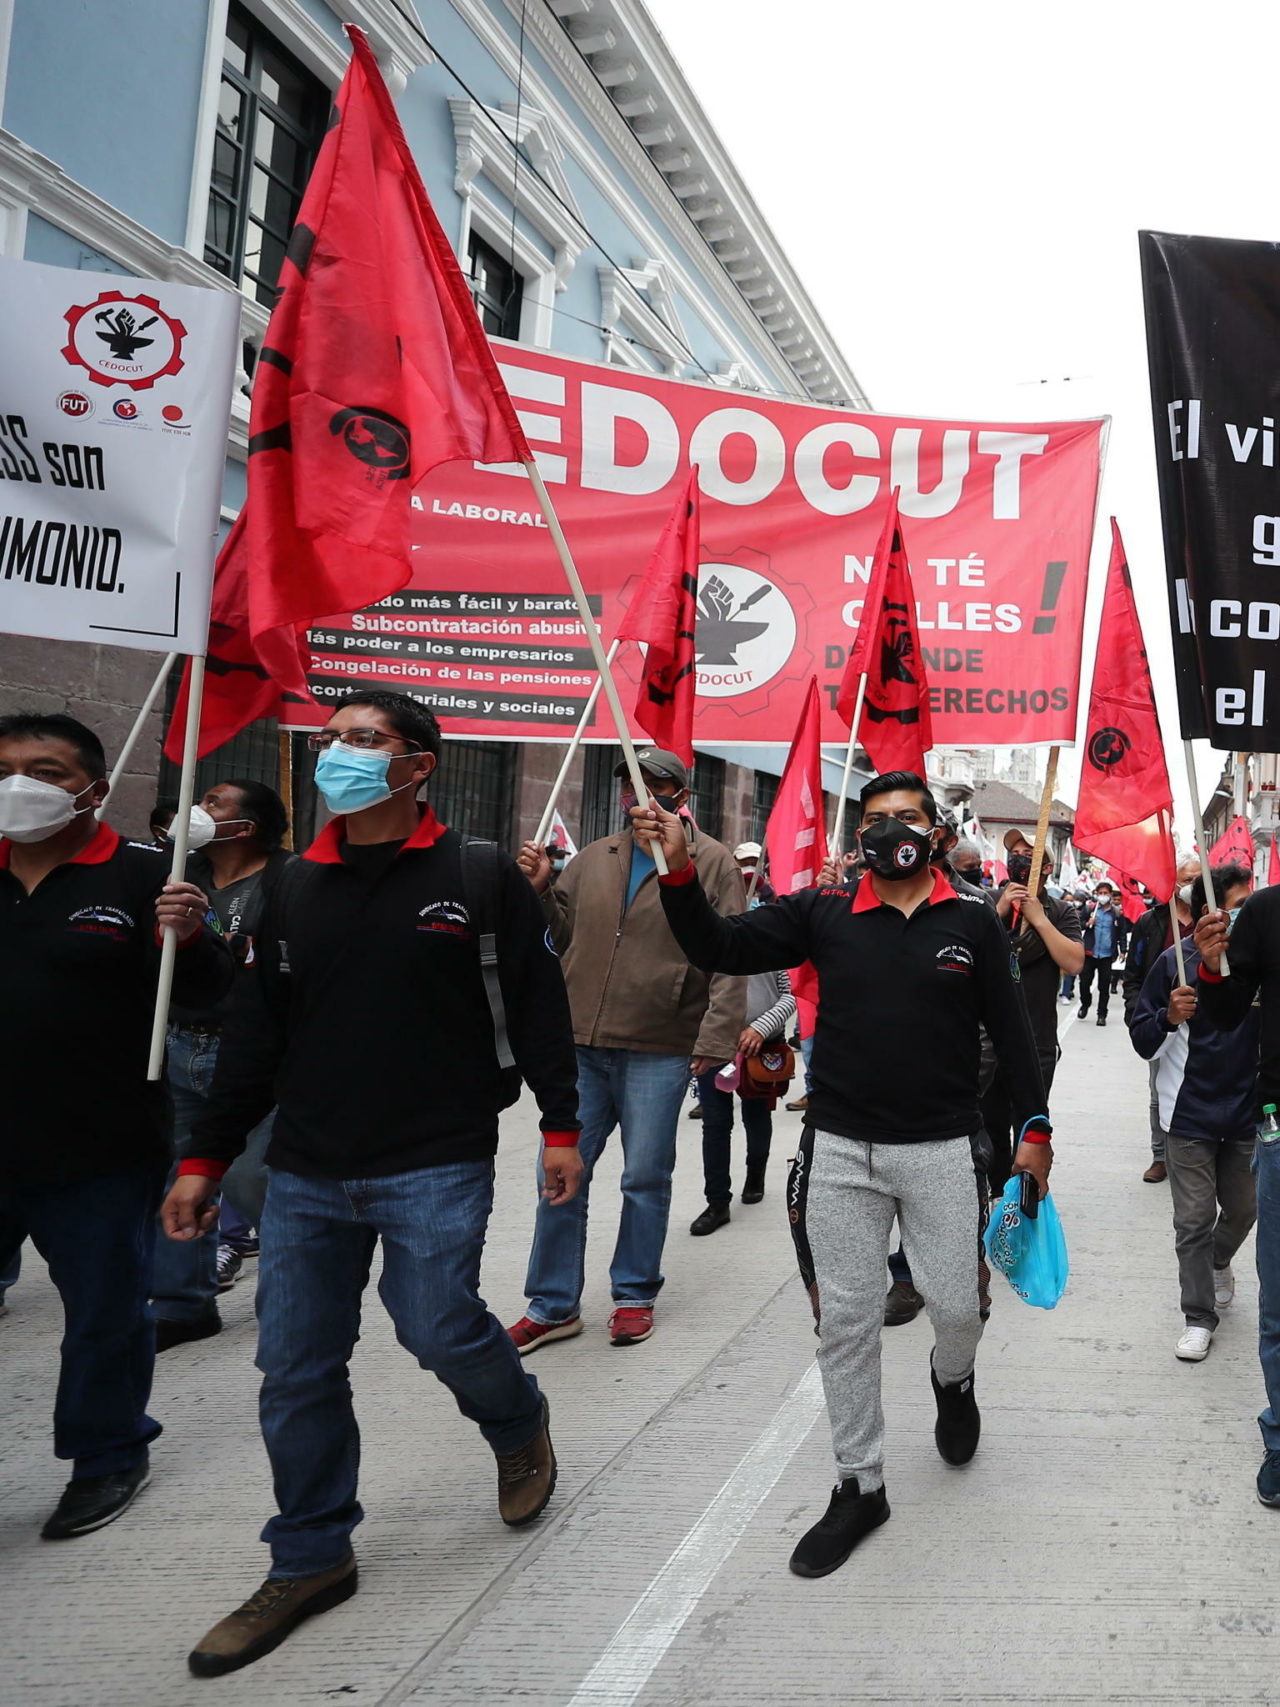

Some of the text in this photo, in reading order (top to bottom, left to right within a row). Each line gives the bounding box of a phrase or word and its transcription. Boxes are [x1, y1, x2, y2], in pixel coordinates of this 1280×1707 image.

[98, 359, 144, 373] CEDOCUT
[62, 398, 87, 412] FUT
[1167, 399, 1200, 462] El
[43, 442, 105, 491] son
[433, 499, 548, 529] LABORAL
[927, 552, 985, 588] TÉ
[411, 596, 452, 609] más
[458, 594, 502, 610] fácil
[507, 600, 518, 613] y
[841, 600, 1022, 634] CLLES
[351, 614, 522, 635] Subcontratación
[343, 637, 402, 650] poder
[407, 643, 419, 652] a
[426, 641, 454, 655] los
[460, 646, 574, 662] empresarios
[310, 656, 592, 685] Congelación de las pensiones
[482, 701, 495, 713] y
[500, 702, 576, 716] sociales
[926, 685, 1069, 714] ERECHOS
[1215, 669, 1266, 727] el
